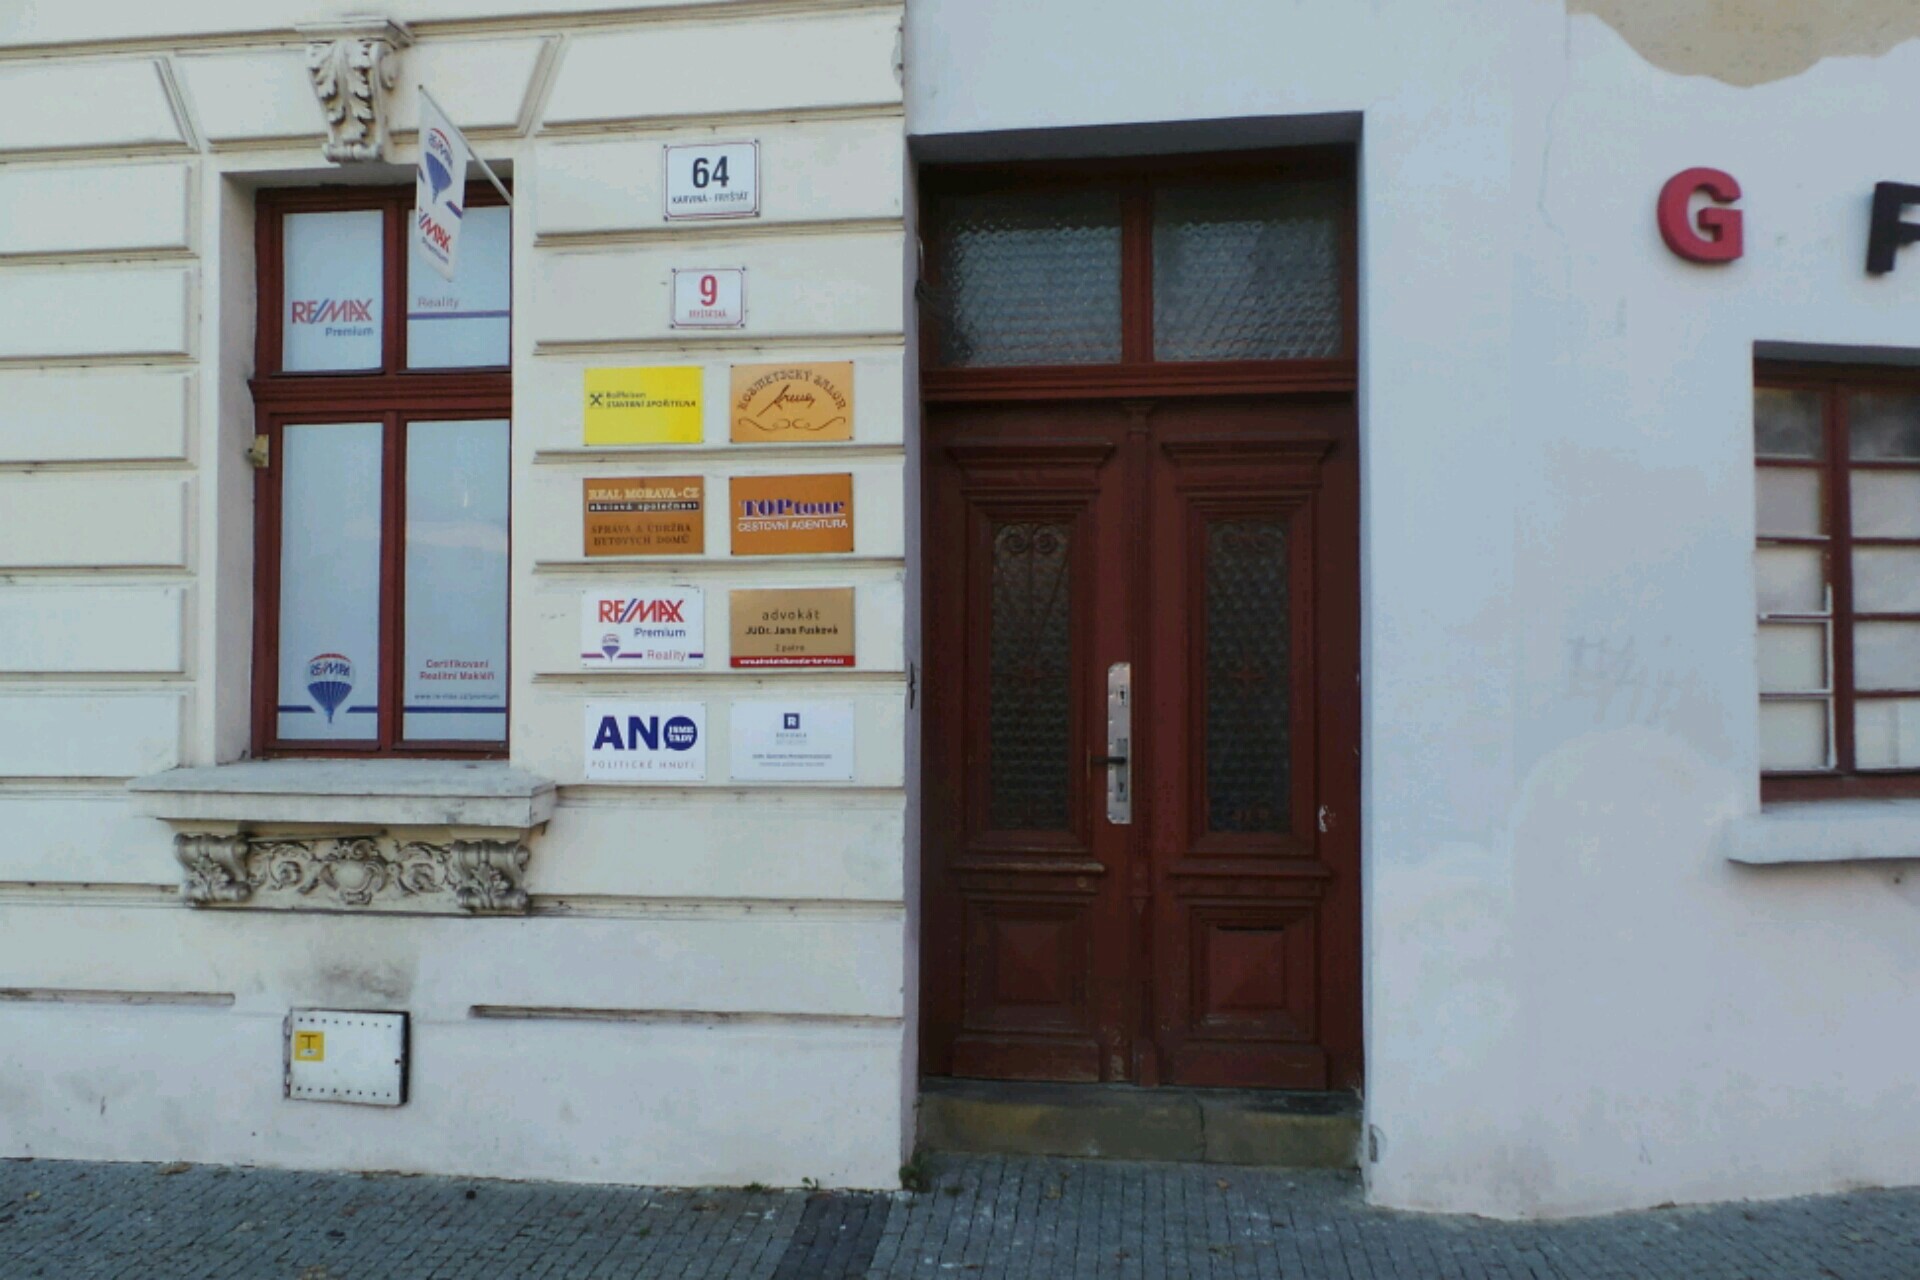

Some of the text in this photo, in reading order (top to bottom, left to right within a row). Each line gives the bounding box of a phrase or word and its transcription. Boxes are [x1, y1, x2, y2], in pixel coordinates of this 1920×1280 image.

[692, 155, 730, 189] 64
[1657, 167, 1743, 264] G
[700, 274, 718, 307] 9
[417, 296, 460, 310] Reality
[292, 298, 373, 324] RE/MAX
[325, 326, 374, 337] Premium
[588, 489, 622, 499] REAL
[791, 518, 848, 530] AGENTURA
[598, 598, 685, 624] RE/MAX
[761, 609, 820, 621] advokát
[633, 627, 687, 638] Premium
[773, 625, 797, 635] Jana
[646, 649, 686, 663] Reality
[592, 716, 698, 751] ANO
